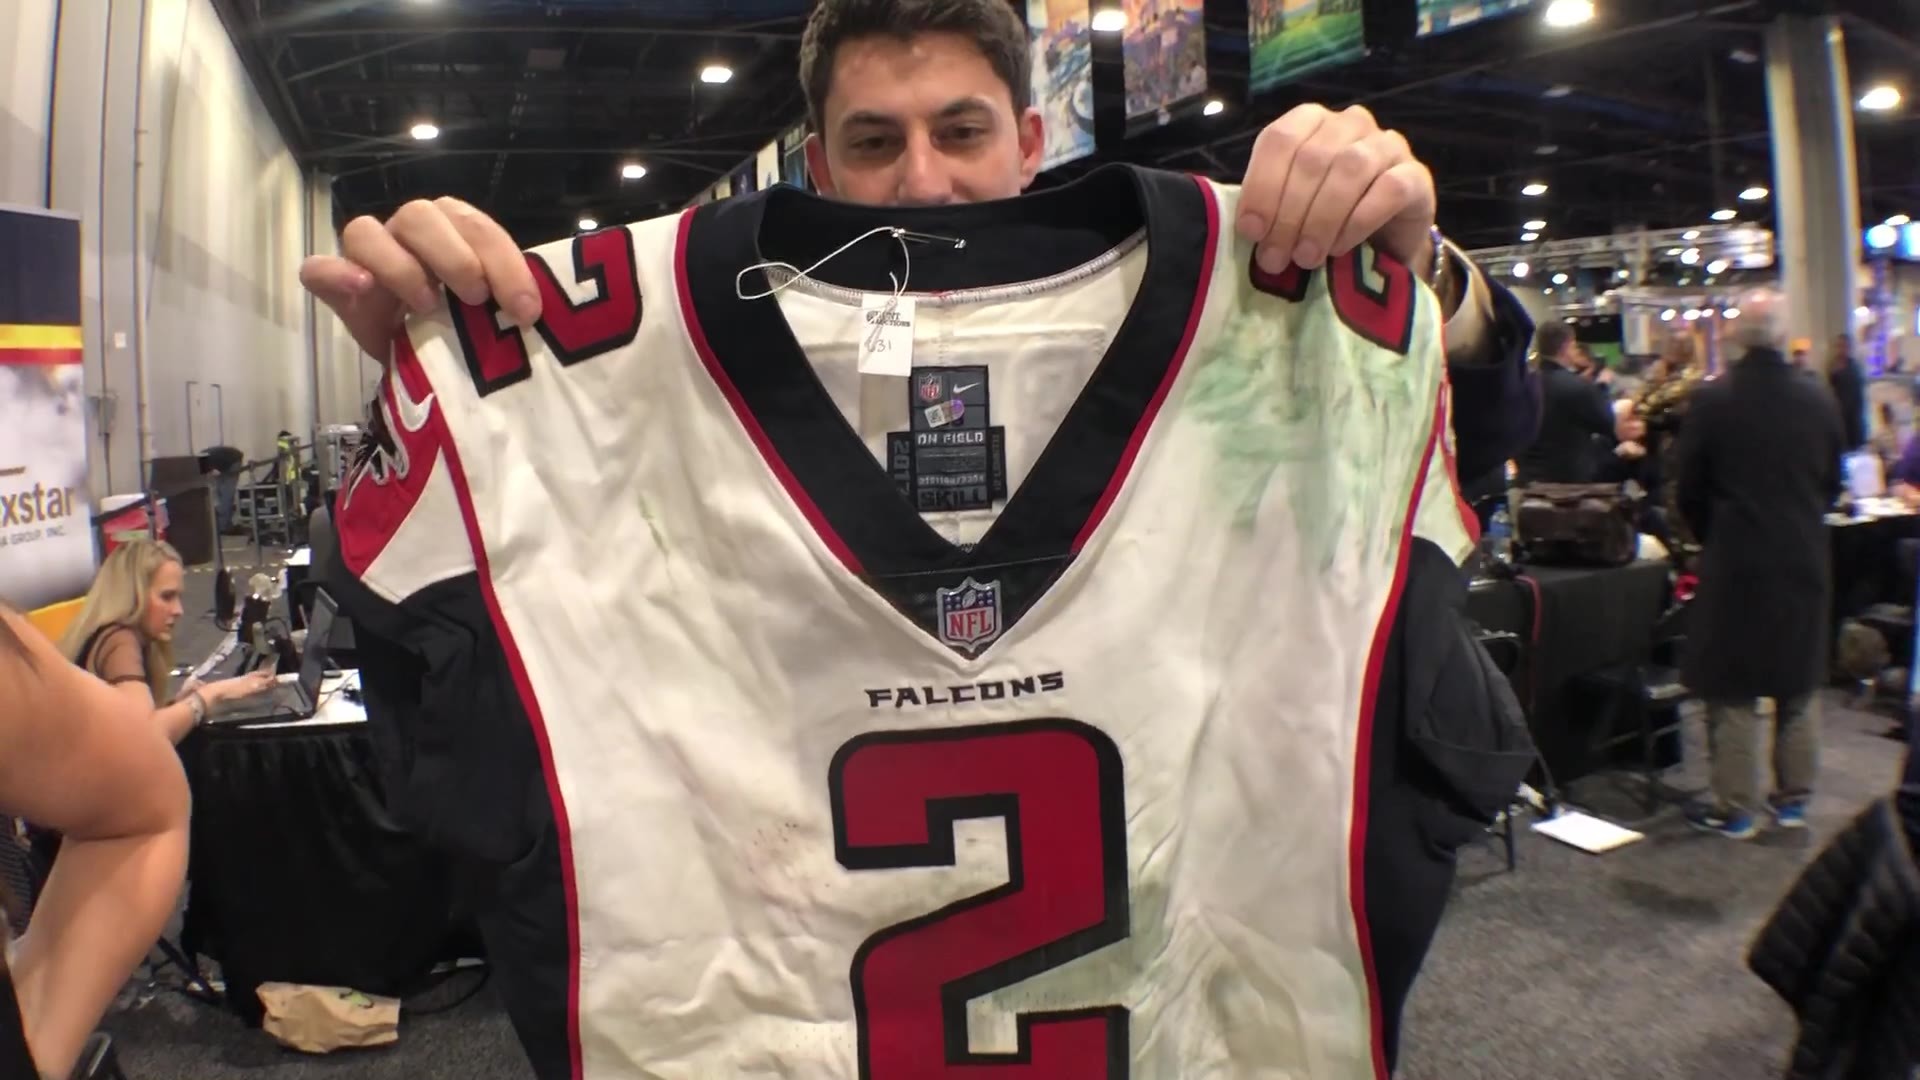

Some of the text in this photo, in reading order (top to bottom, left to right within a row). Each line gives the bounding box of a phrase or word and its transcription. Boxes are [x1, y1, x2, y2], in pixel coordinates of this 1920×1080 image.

[918, 432, 984, 445] ON FIELD
[0, 482, 74, 528] xstar
[948, 609, 992, 638] NFL
[864, 671, 1064, 708] FALCONS
[828, 717, 1130, 1080] 2
